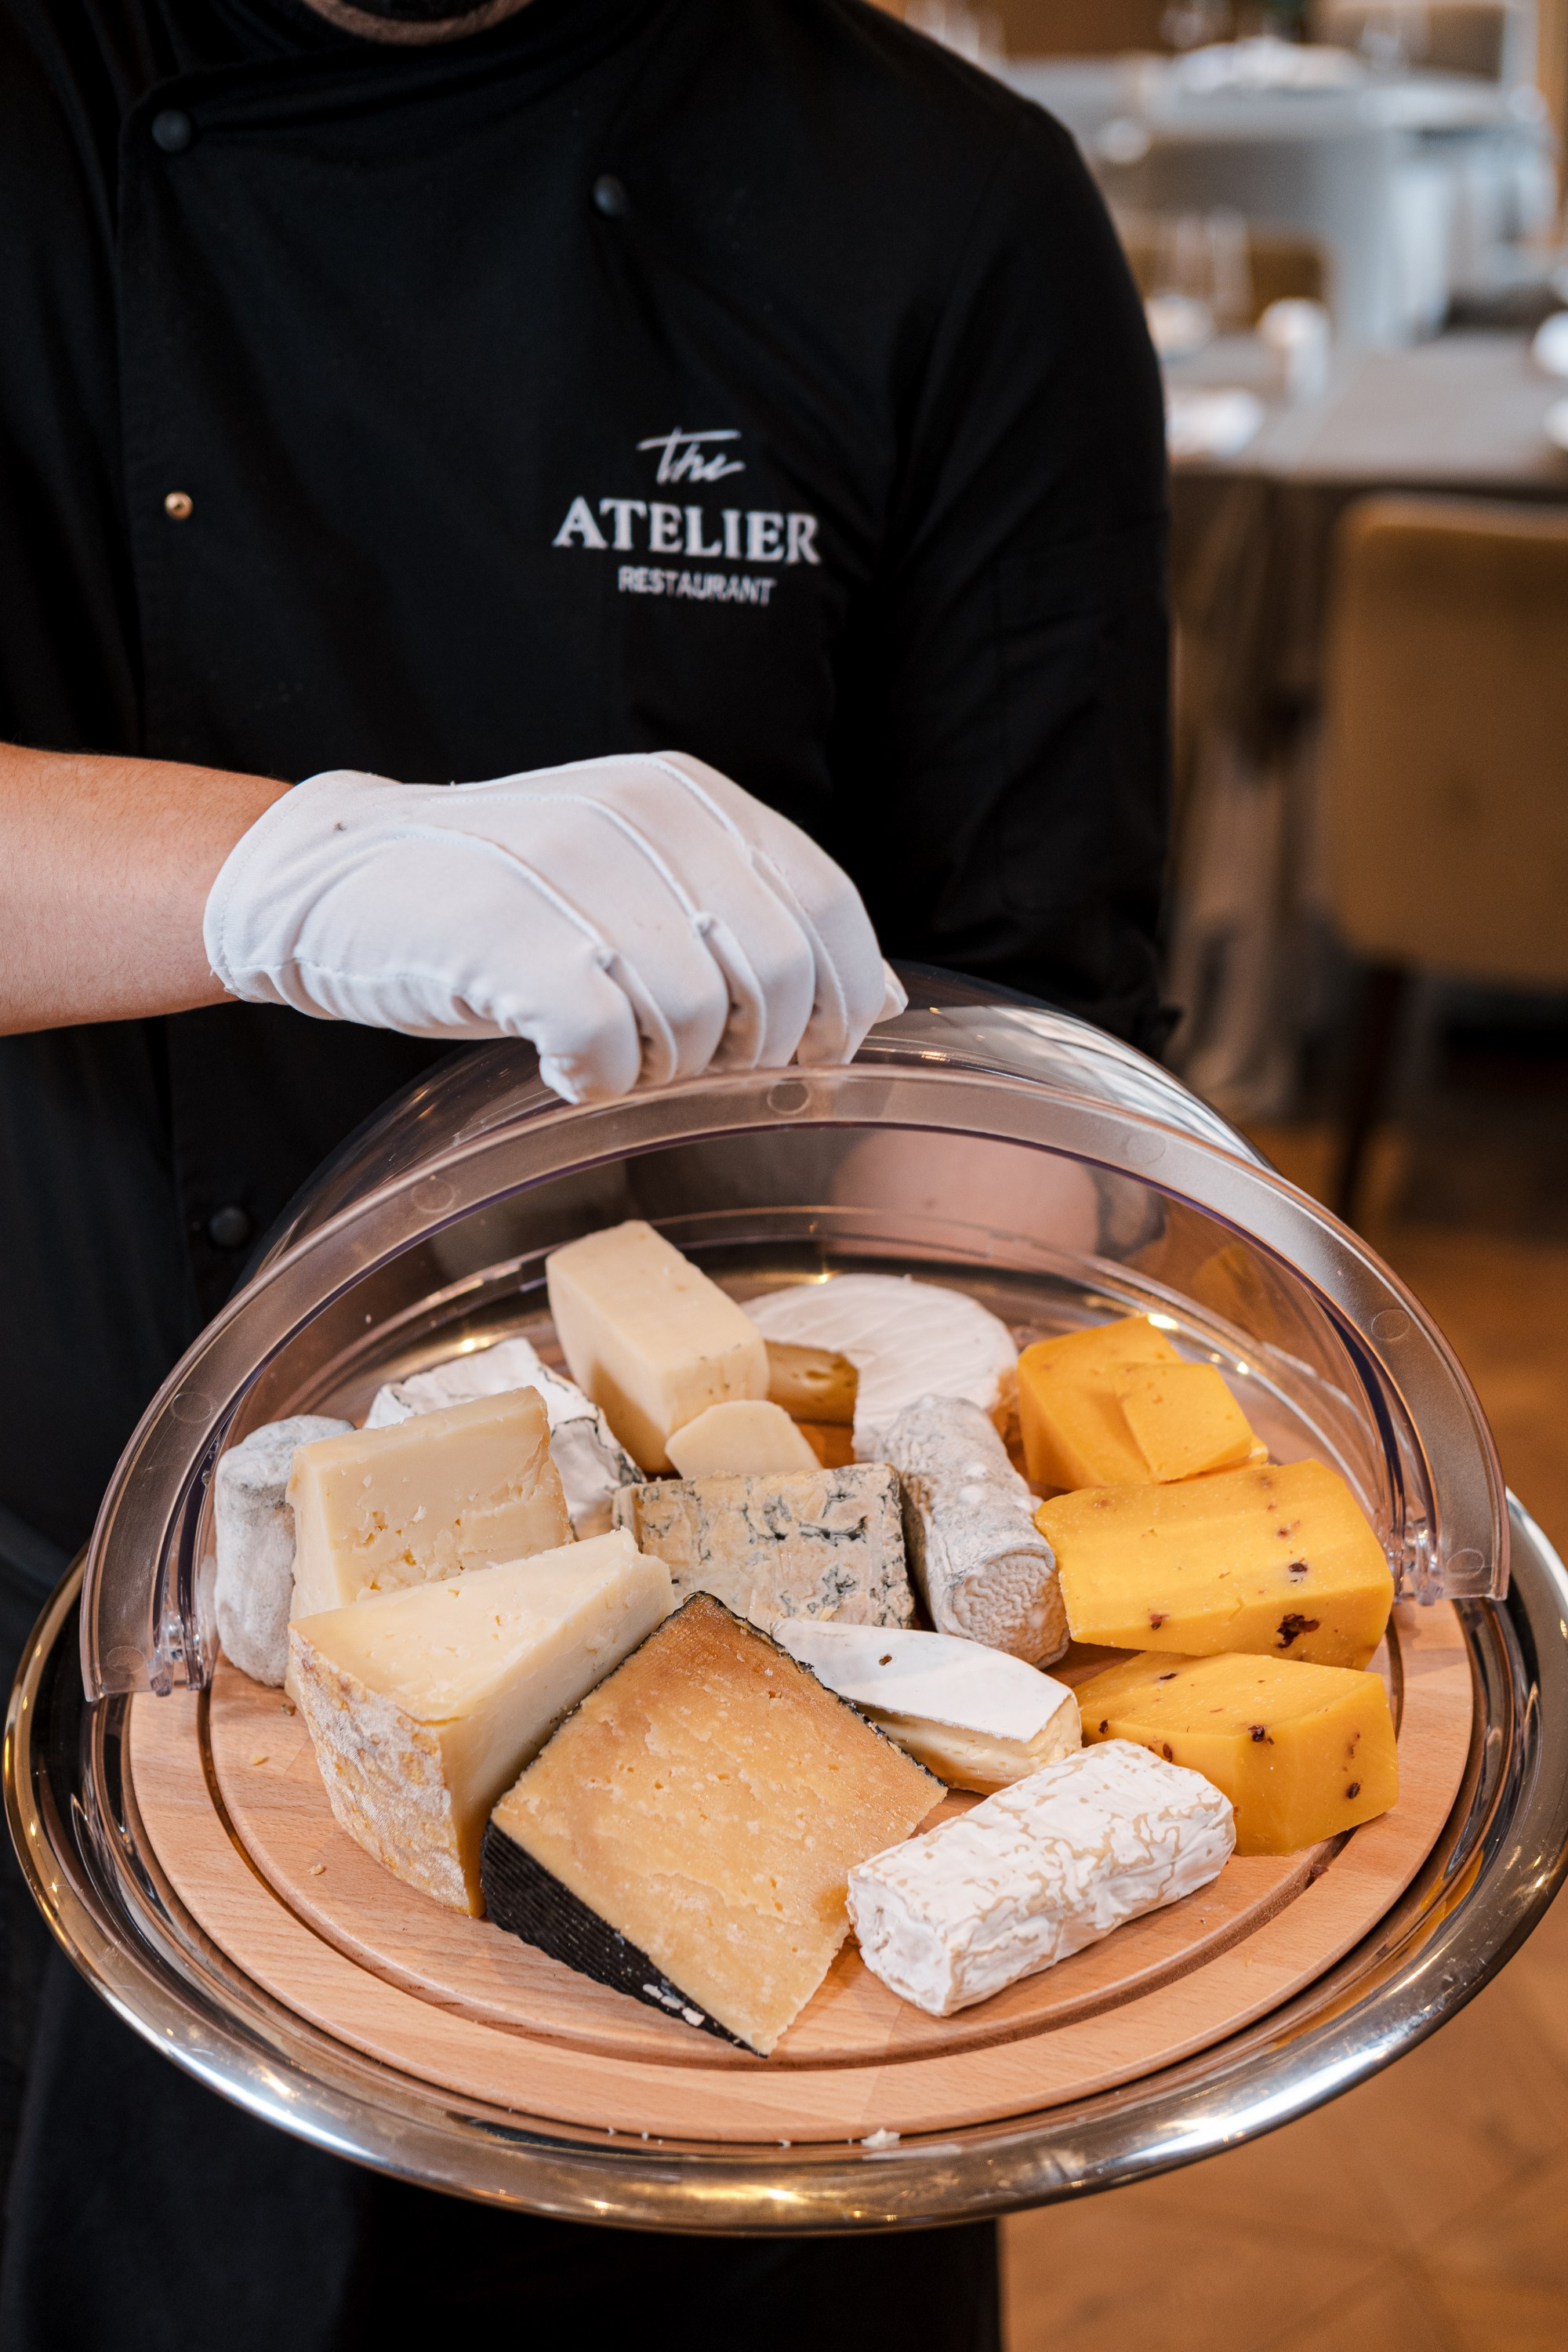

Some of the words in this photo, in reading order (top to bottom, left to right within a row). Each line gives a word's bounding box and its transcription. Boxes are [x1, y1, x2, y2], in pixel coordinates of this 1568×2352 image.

[637, 427, 745, 485] The
[553, 495, 821, 564] ATELIER
[618, 565, 775, 606] RESTAURANT
